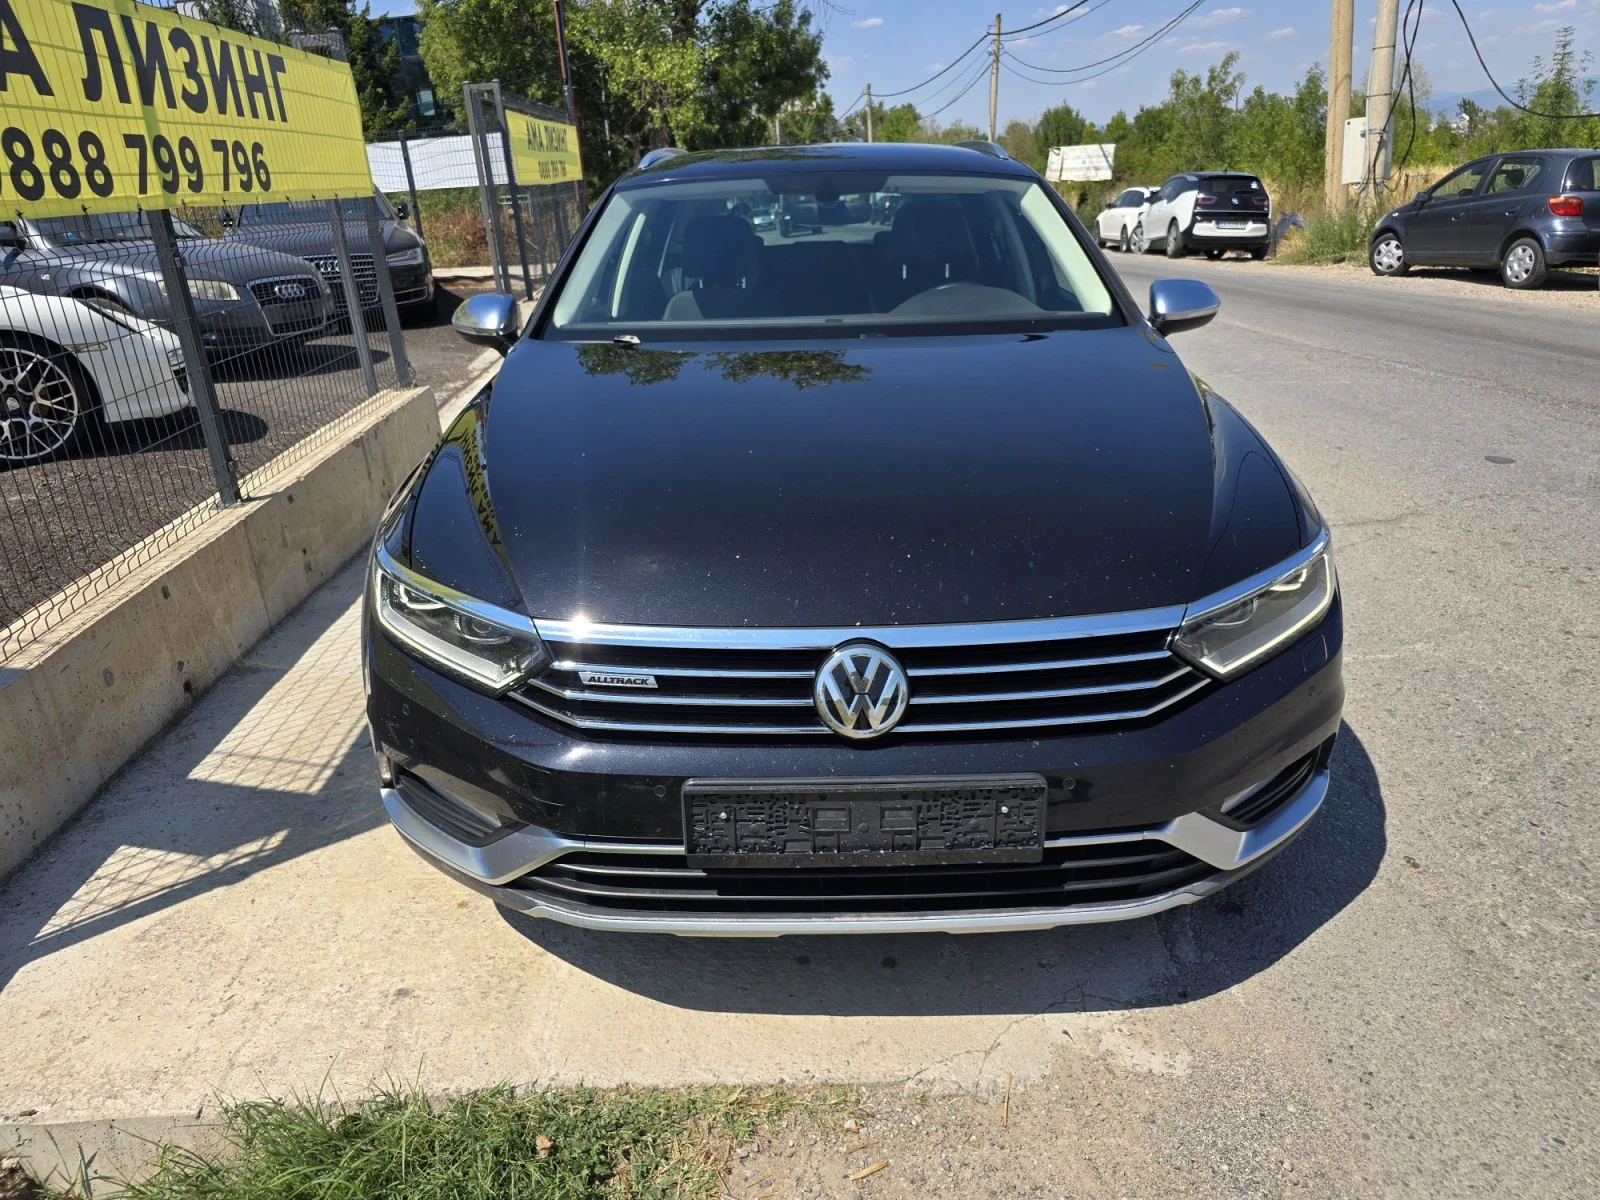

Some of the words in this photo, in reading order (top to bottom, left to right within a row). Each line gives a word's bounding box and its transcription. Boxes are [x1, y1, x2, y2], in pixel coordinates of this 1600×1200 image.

[72, 2, 288, 123] ЛИЗИНГ
[0, 127, 114, 201] 888
[123, 133, 204, 195] 799
[211, 139, 271, 192] 796
[588, 676, 649, 686] ALLTRACK
